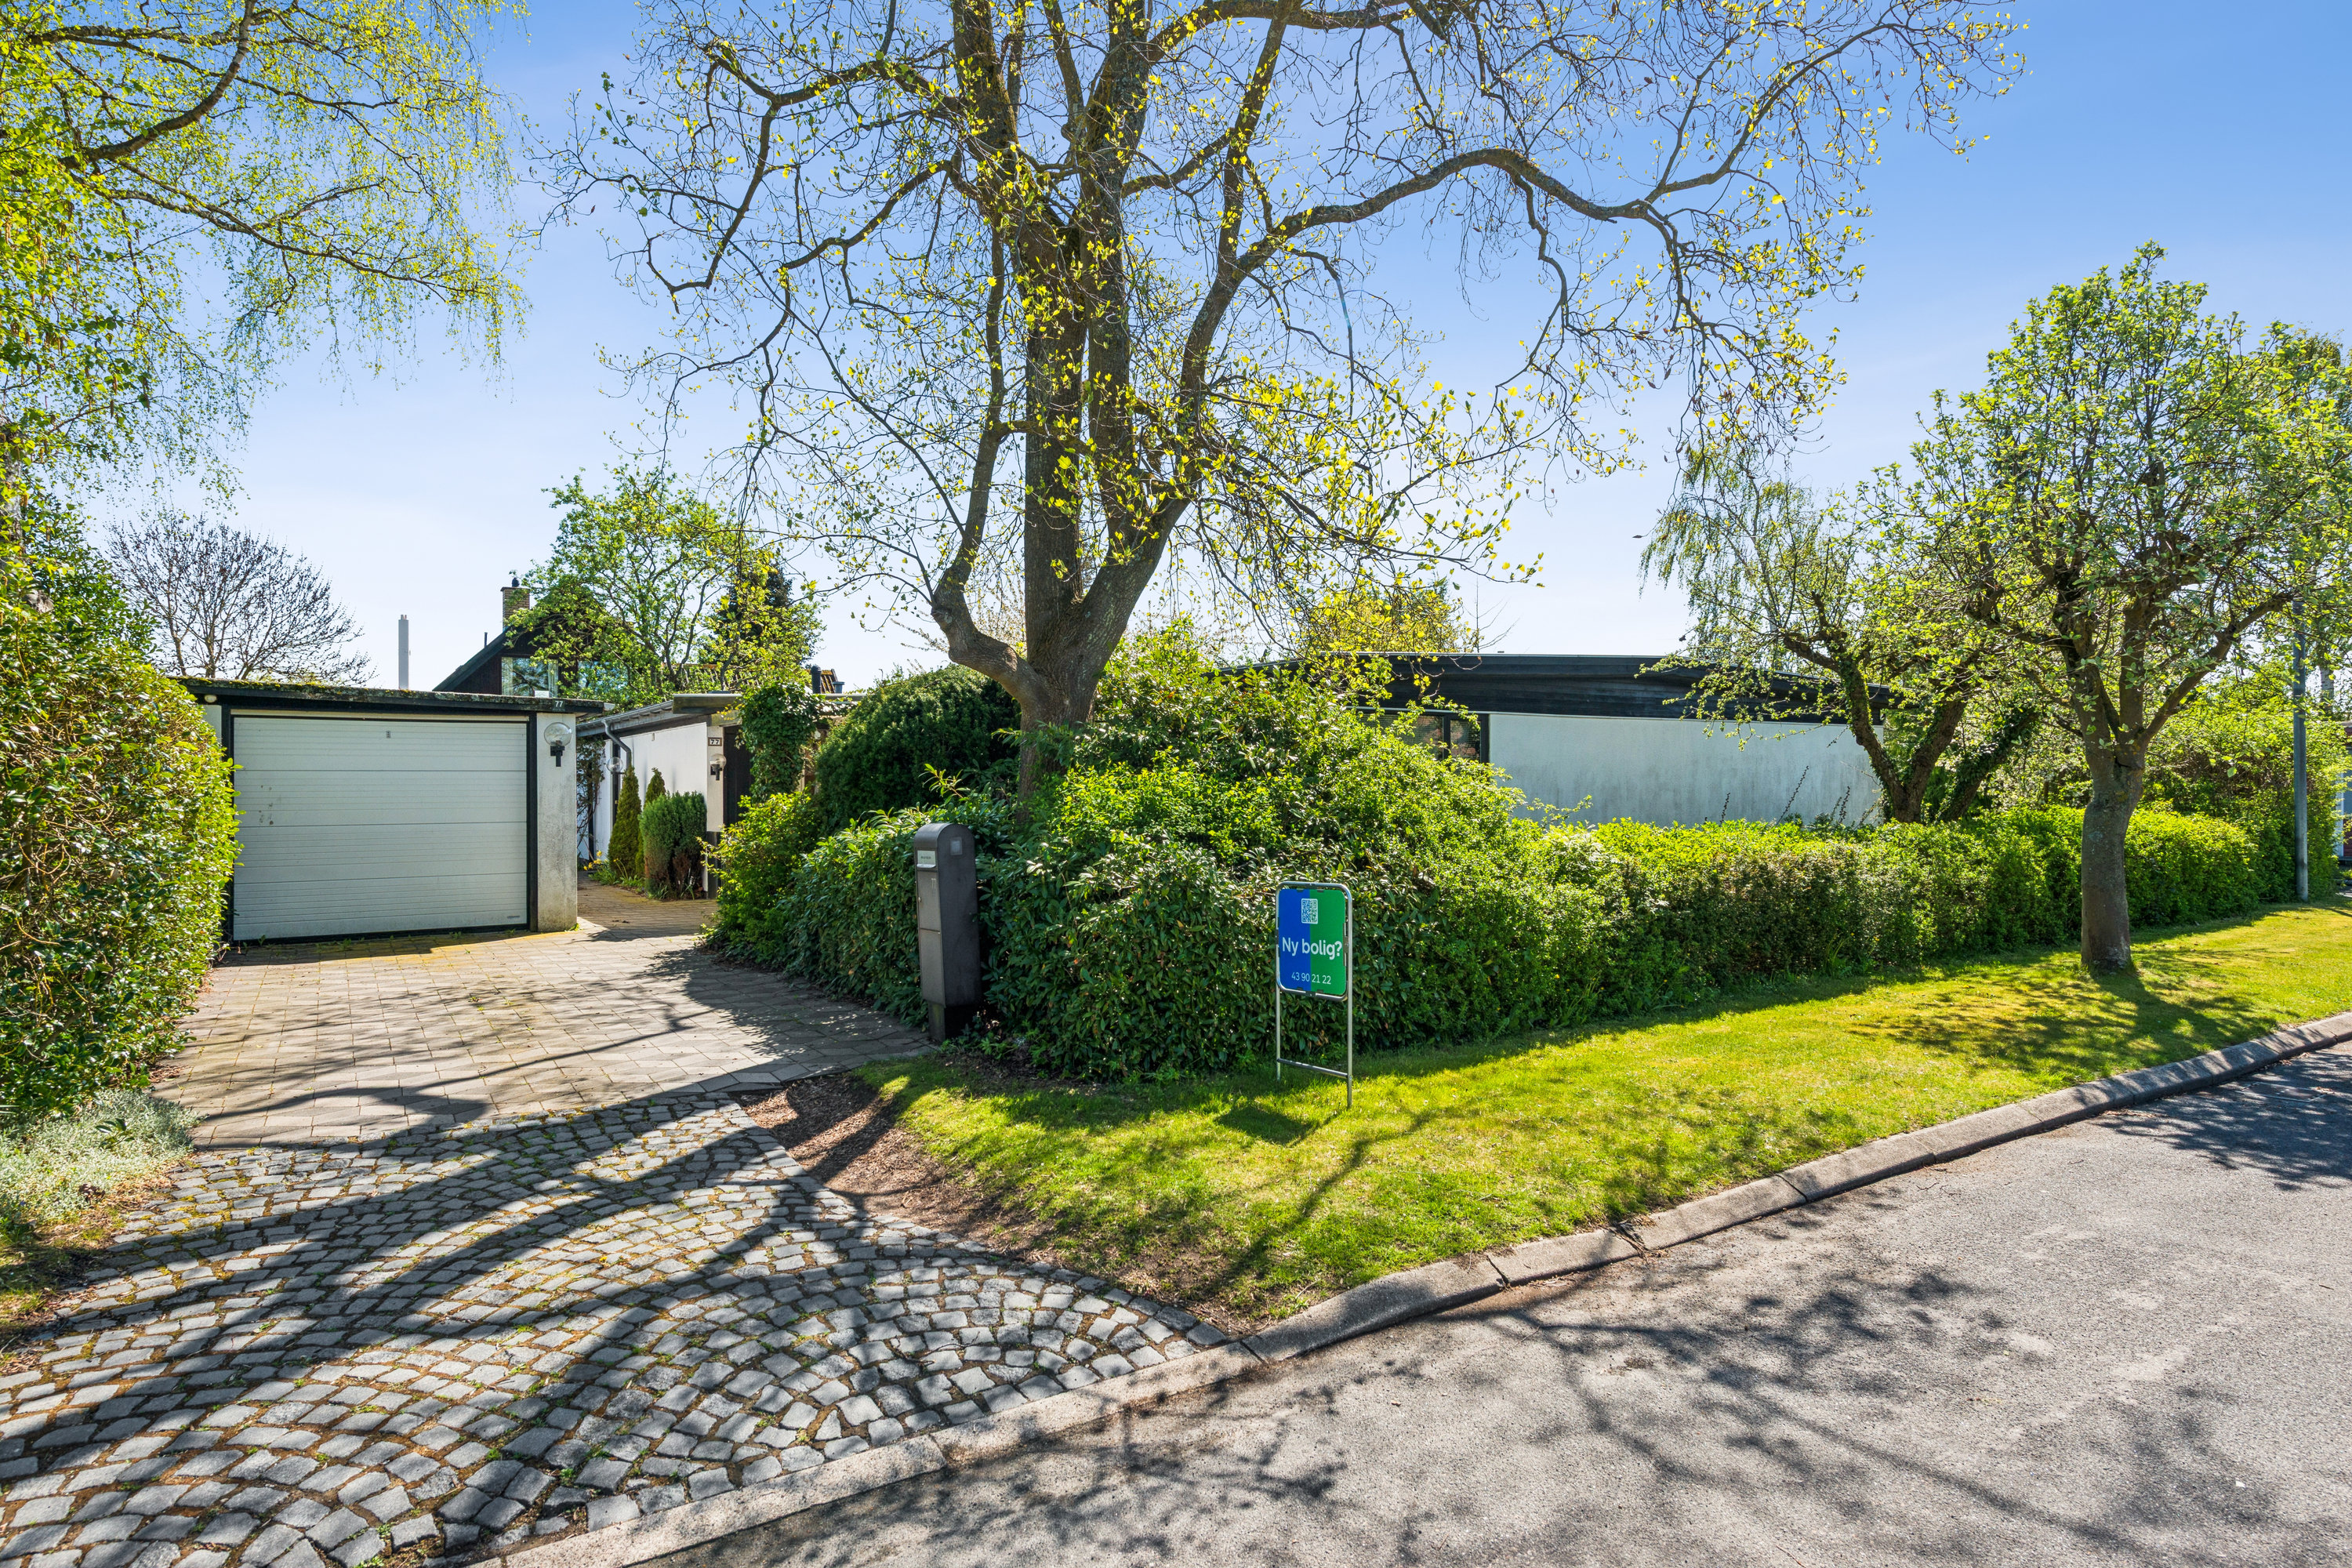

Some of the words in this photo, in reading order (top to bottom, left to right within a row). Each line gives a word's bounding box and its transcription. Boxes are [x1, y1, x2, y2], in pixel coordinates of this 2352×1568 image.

[1282, 937, 1299, 956] Ny
[1301, 938, 1343, 960] bolig?
[1291, 972, 1300, 981] 43
[1301, 972, 1310, 982] 90
[1312, 974, 1321, 984] 21
[1322, 975, 1332, 985] 22
